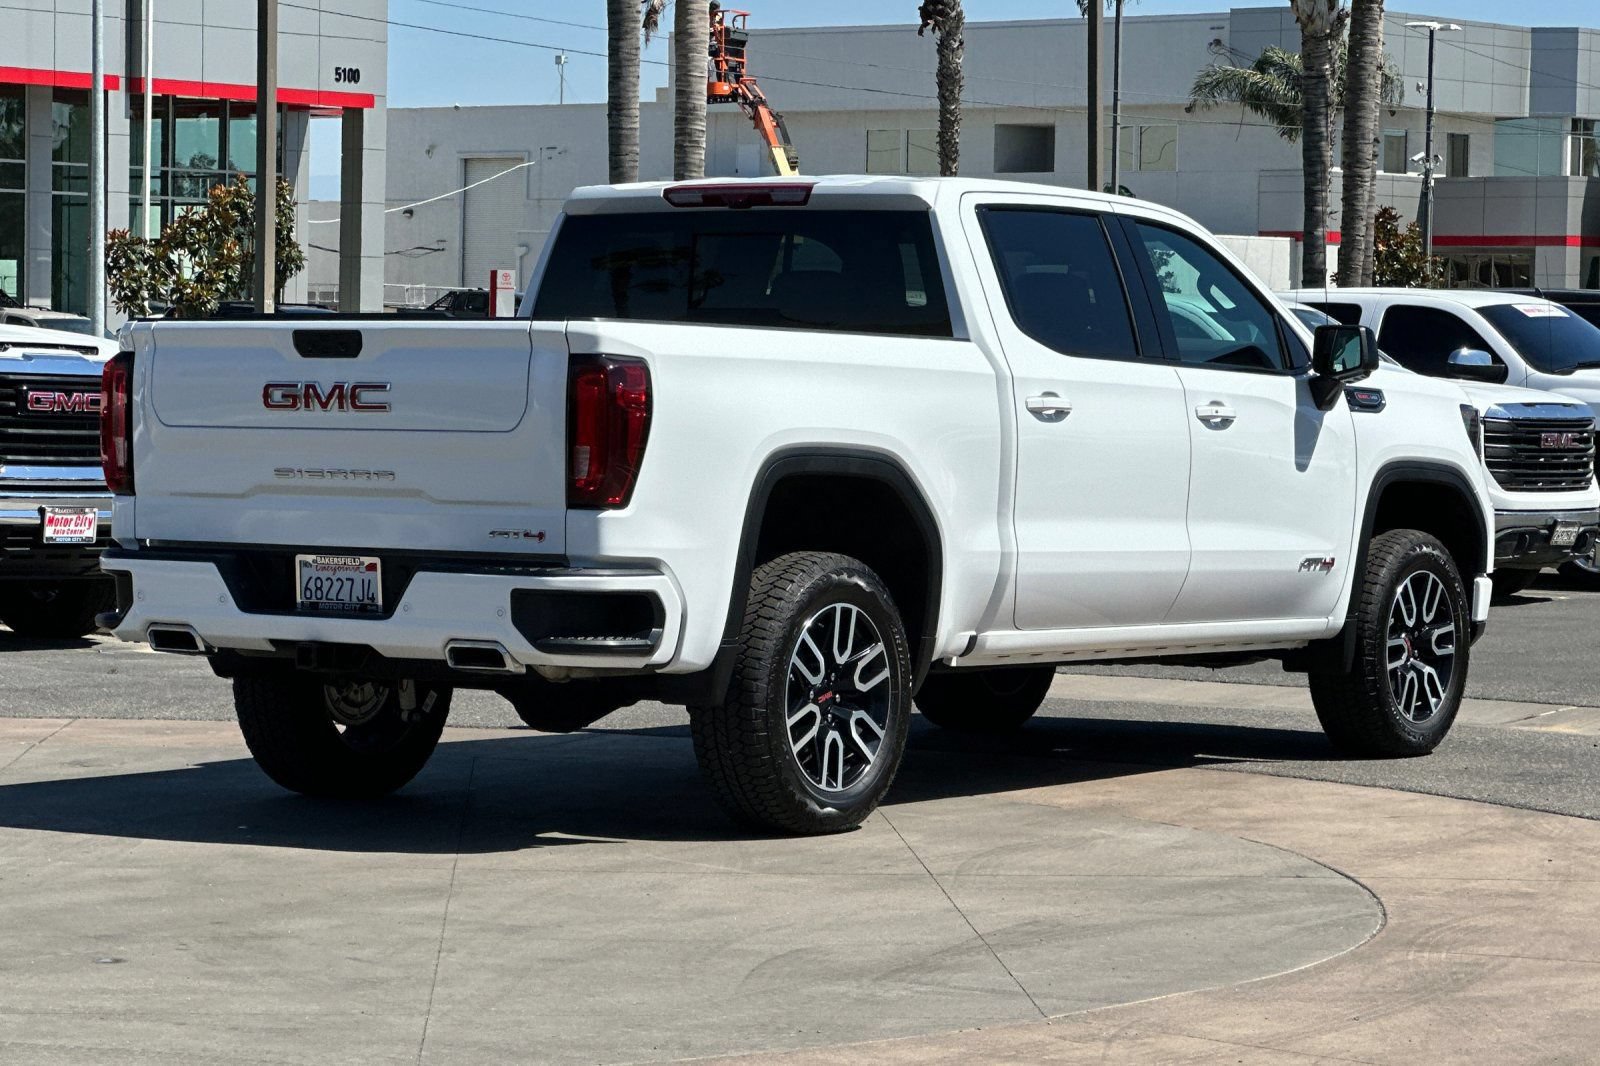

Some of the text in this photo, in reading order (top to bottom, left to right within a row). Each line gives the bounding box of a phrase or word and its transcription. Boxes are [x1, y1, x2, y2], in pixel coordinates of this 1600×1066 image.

[335, 66, 360, 84] 5100
[27, 391, 103, 412] GMC
[262, 381, 392, 412] GMC
[1541, 433, 1581, 449] GMC
[273, 467, 396, 481] SIERRA
[46, 514, 93, 530] Motor City
[489, 528, 545, 543] AT4
[315, 556, 360, 566] BAKERSFIELD
[1298, 556, 1335, 576] AT4
[303, 575, 376, 603] 68227J4
[319, 602, 343, 610] MOTOR
[344, 603, 360, 611] CITY
